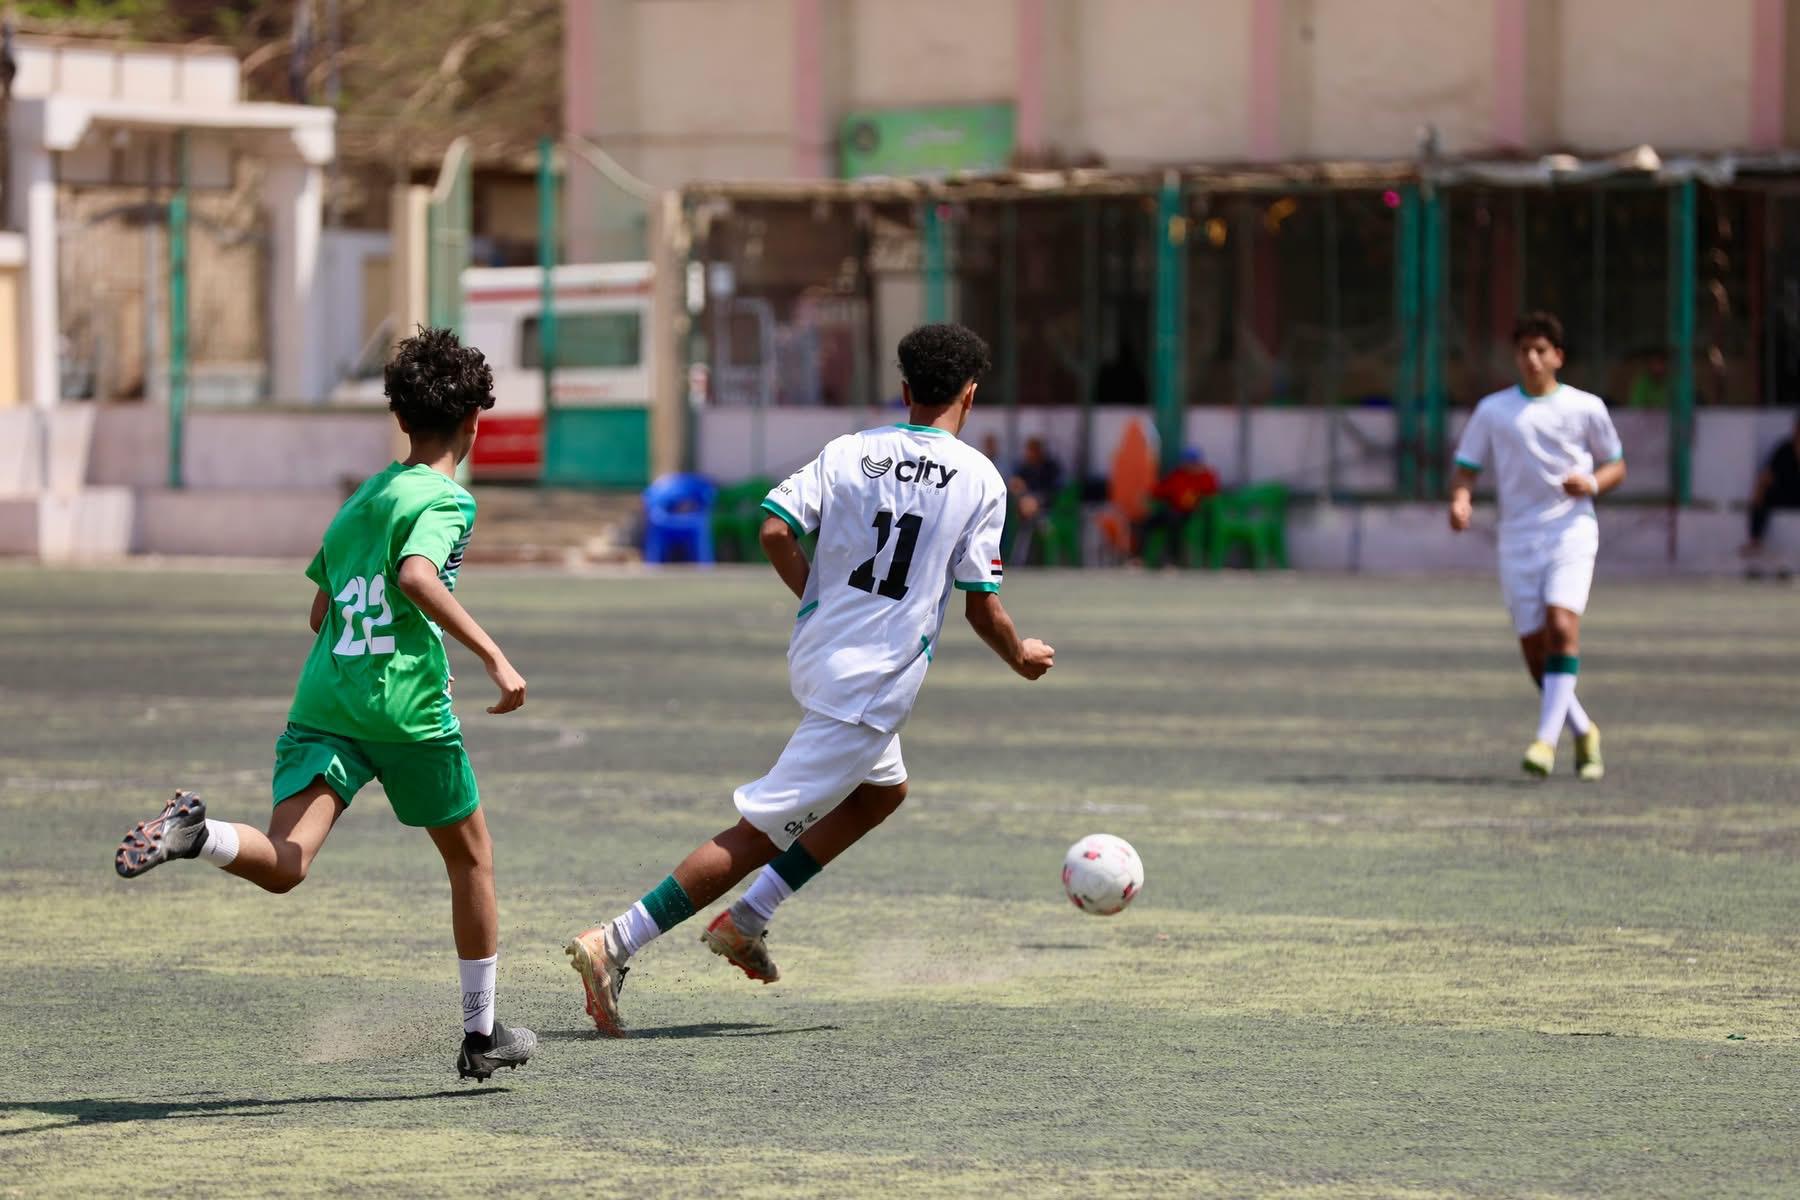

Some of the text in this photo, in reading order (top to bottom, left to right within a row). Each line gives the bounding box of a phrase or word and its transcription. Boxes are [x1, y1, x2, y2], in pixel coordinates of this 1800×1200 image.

[895, 455, 958, 489] city
[847, 511, 923, 601] 11
[332, 574, 395, 656] 22
